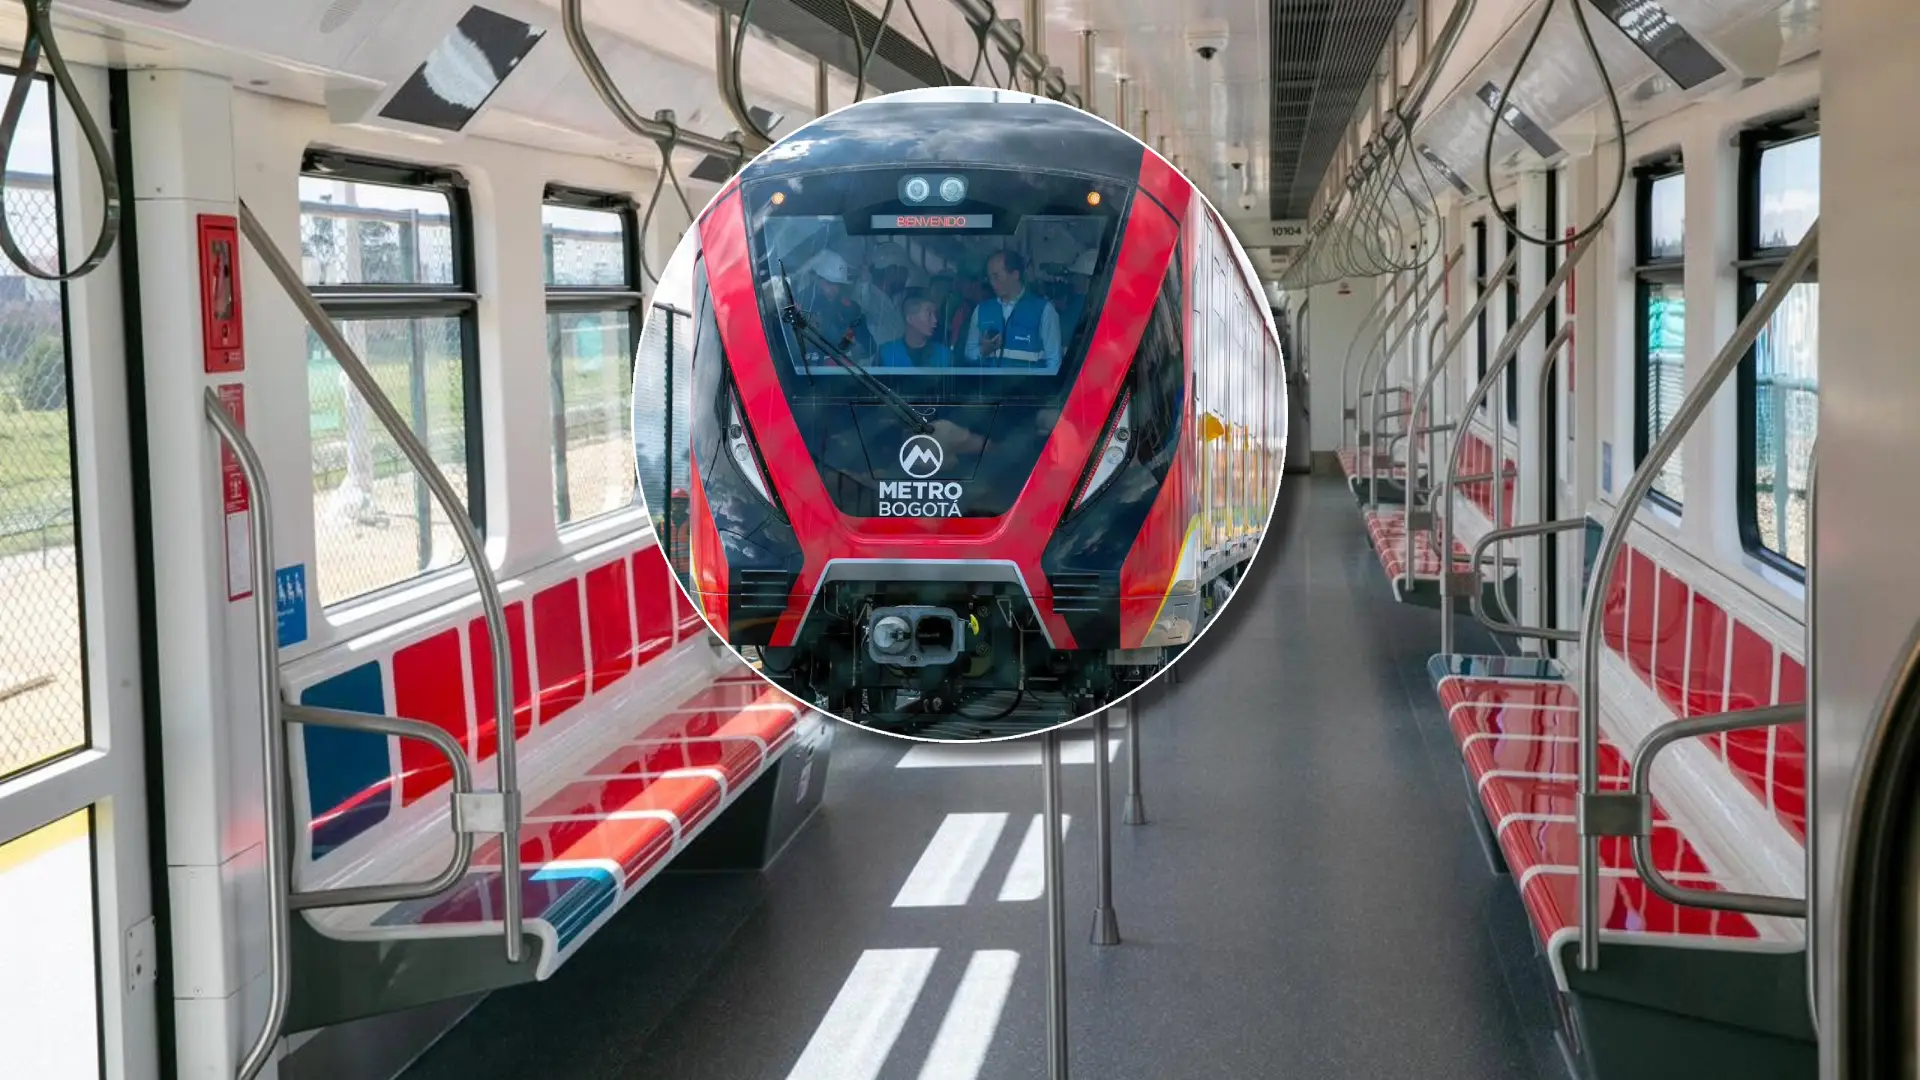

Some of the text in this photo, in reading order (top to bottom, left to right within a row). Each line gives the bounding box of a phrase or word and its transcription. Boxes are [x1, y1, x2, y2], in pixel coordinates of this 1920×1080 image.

[896, 215, 967, 227] BIENVENIDO
[1271, 226, 1302, 236] 10104
[879, 481, 963, 500] METRO
[878, 499, 962, 517] BOGOTÁ
